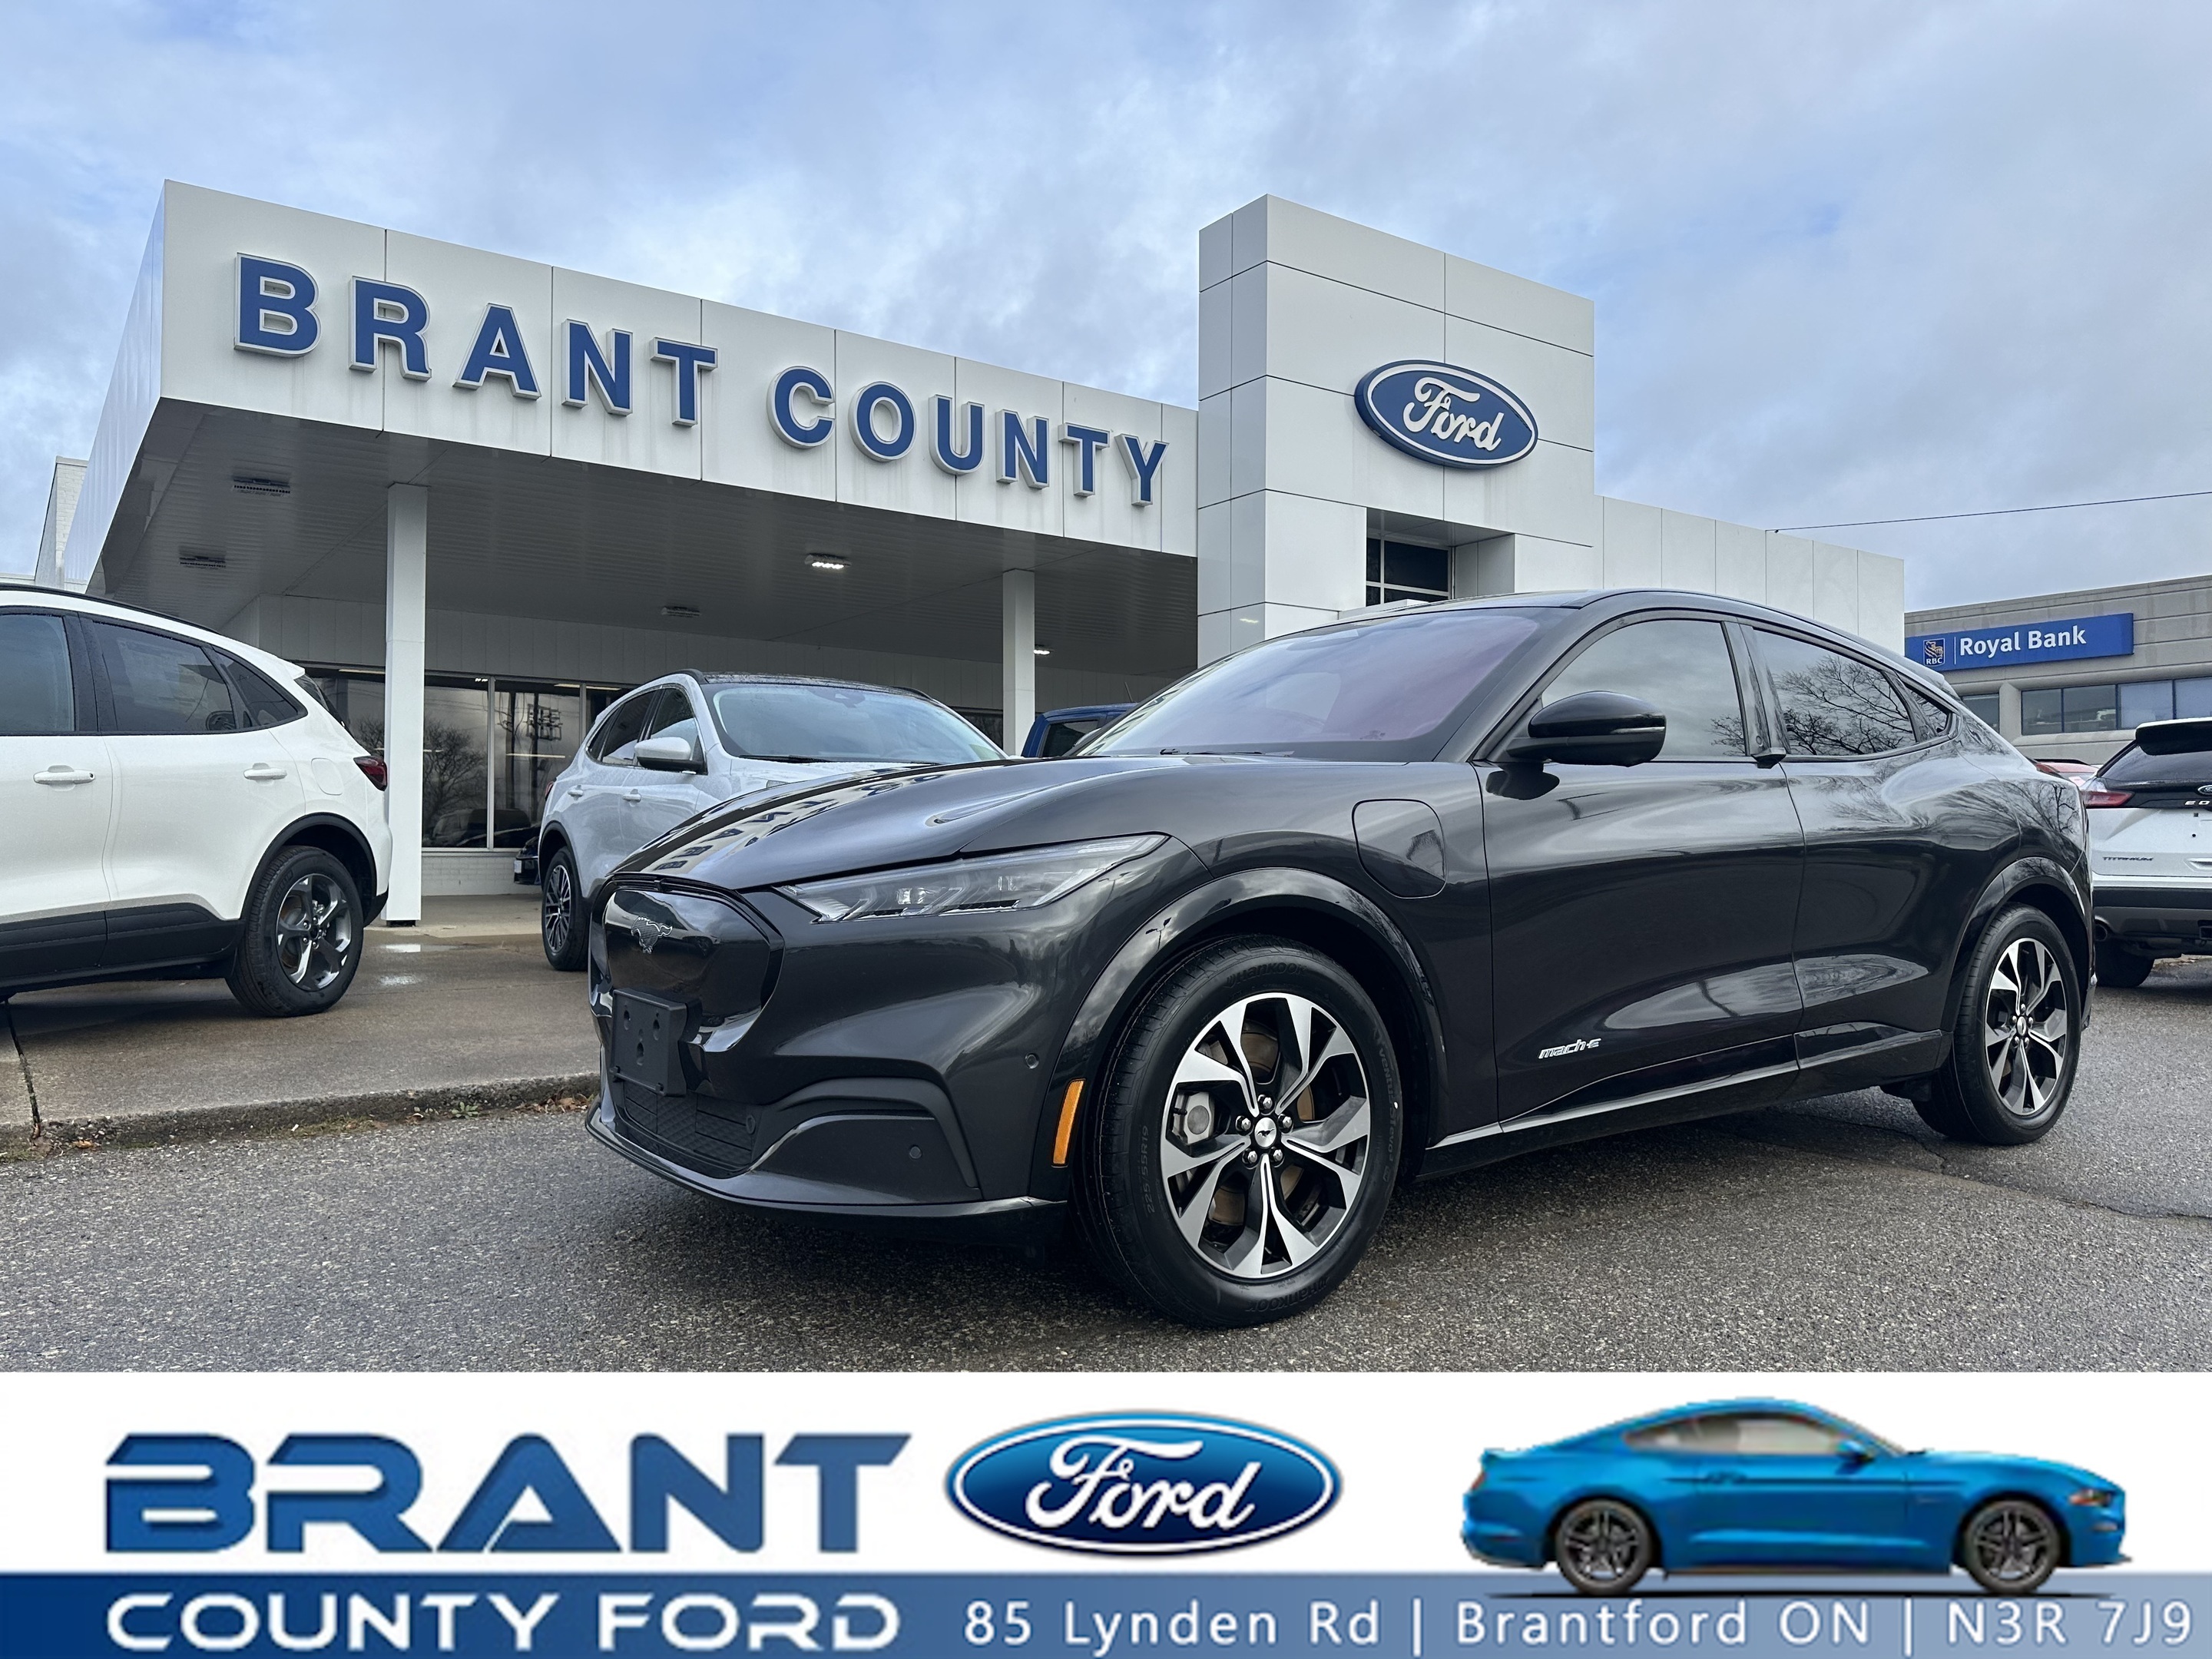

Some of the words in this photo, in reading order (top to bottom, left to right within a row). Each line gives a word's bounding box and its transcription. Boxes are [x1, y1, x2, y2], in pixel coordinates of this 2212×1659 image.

[234, 252, 719, 428] BRANT
[768, 365, 1171, 508] COUNTY
[1402, 376, 1505, 452] Ford
[1926, 657, 1944, 666] RBC
[1959, 631, 2022, 658] Royal
[2028, 624, 2088, 650] Bank
[1141, 1125, 1155, 1214] 225/55R19
